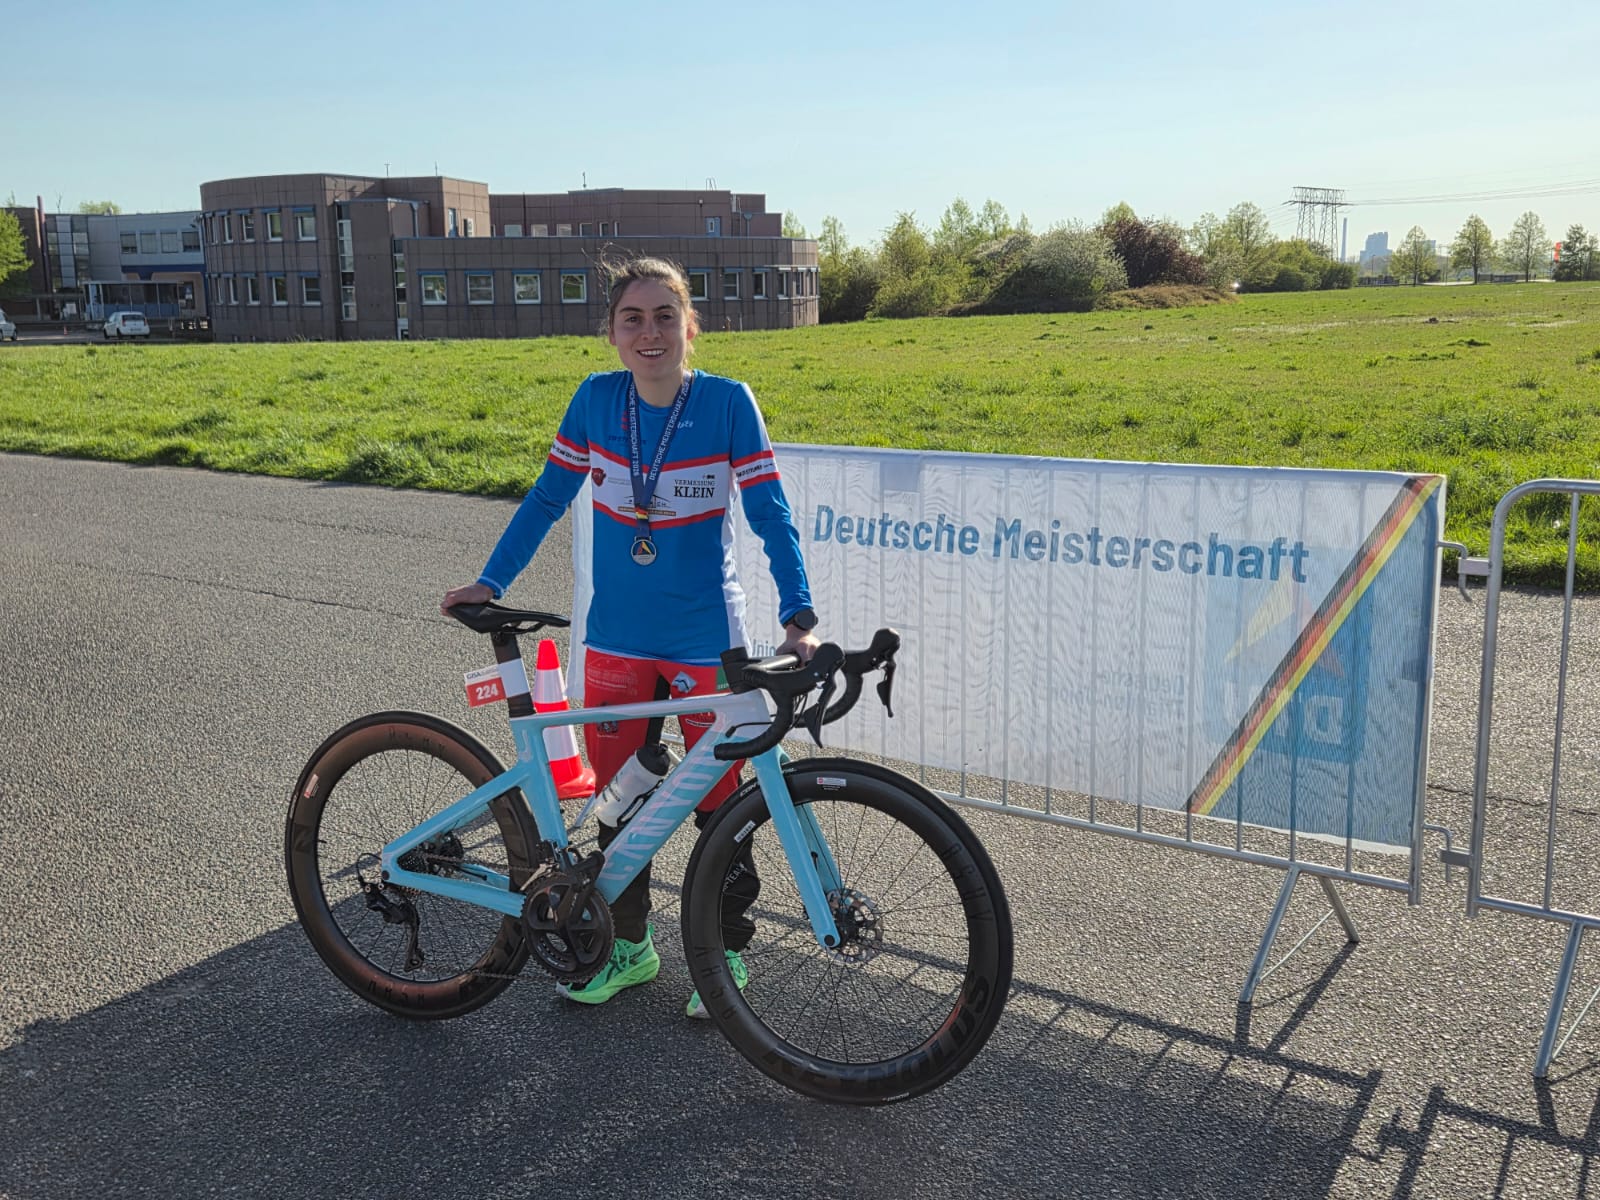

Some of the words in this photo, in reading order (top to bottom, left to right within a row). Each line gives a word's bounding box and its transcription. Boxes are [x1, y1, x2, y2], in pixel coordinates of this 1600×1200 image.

[649, 445, 666, 481] DEUTSCHE
[661, 395, 685, 446] MEISTERSCHAFT
[674, 486, 715, 498] KLEIN
[813, 494, 980, 556] Deutsche
[992, 517, 1310, 584] Meisterschaft
[475, 683, 500, 701] 224
